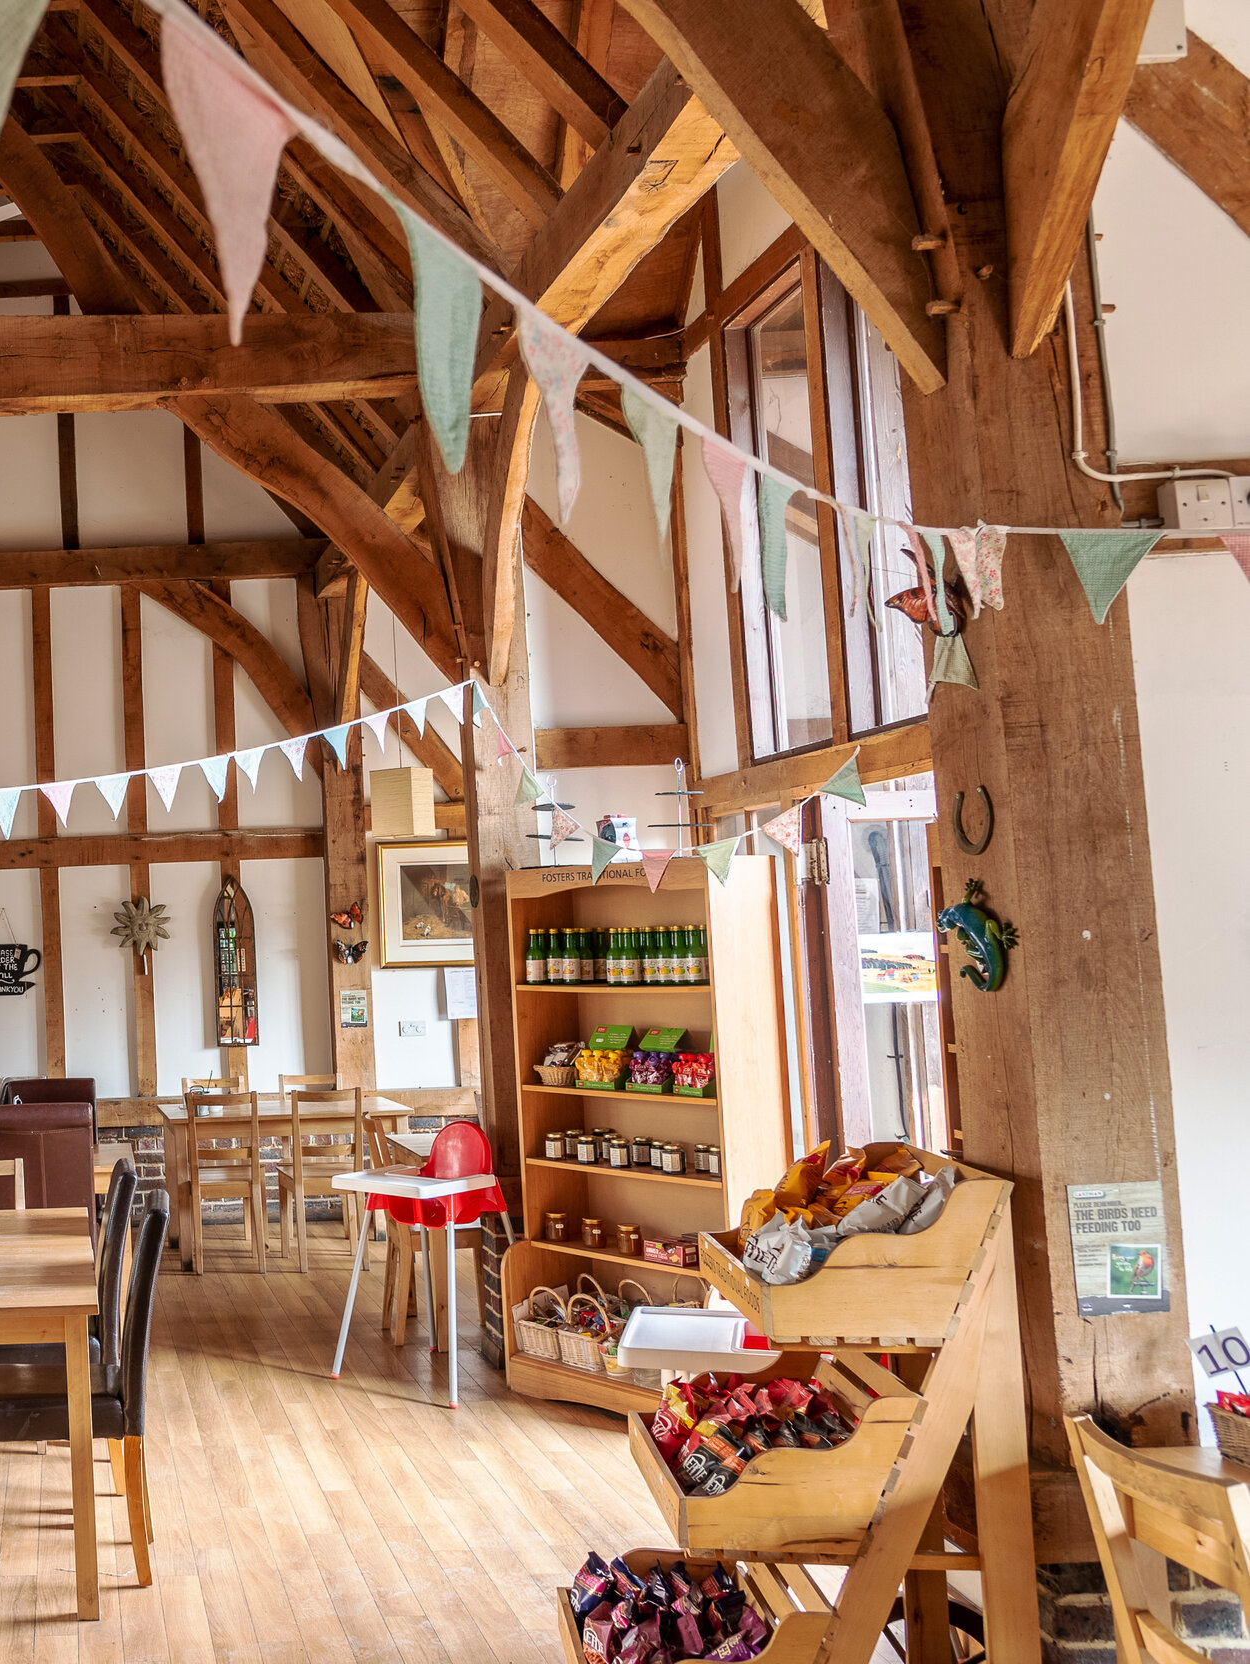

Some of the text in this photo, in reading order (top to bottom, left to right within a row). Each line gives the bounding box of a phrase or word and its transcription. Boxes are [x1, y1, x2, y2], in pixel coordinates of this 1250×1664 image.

[541, 872, 575, 882] FOSTERS
[576, 869, 633, 881] TRATIONAL
[3, 963, 18, 971] THE
[1074, 1206, 1158, 1221] THE BIRDS NEED
[1076, 1220, 1142, 1234] FEEDING TOO
[1197, 1336, 1250, 1375] 10
